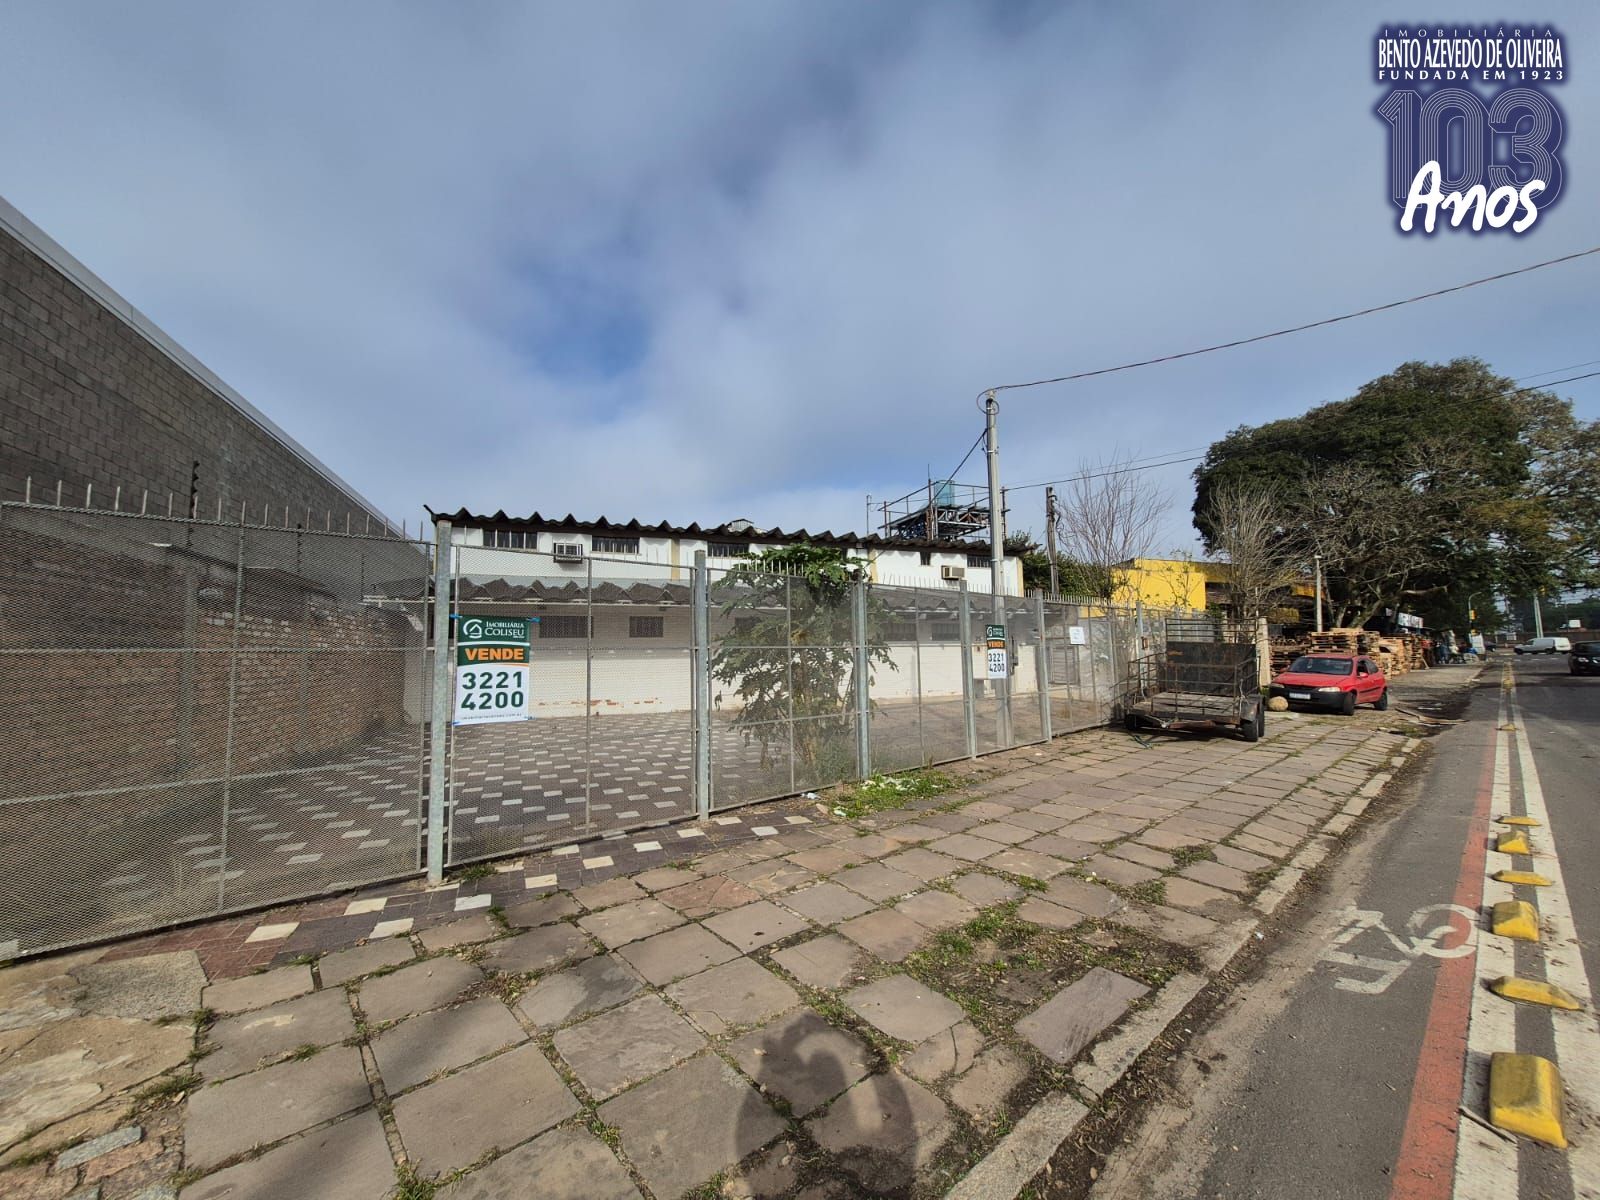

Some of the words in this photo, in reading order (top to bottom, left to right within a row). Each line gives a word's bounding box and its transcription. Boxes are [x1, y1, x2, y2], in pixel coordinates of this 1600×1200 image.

[484, 627, 525, 636] COLISEU
[465, 648, 524, 660] VENDE
[988, 653, 1004, 662] 3221
[989, 663, 1005, 672] 4200
[462, 671, 522, 690] 3221
[461, 691, 524, 710] 4200
